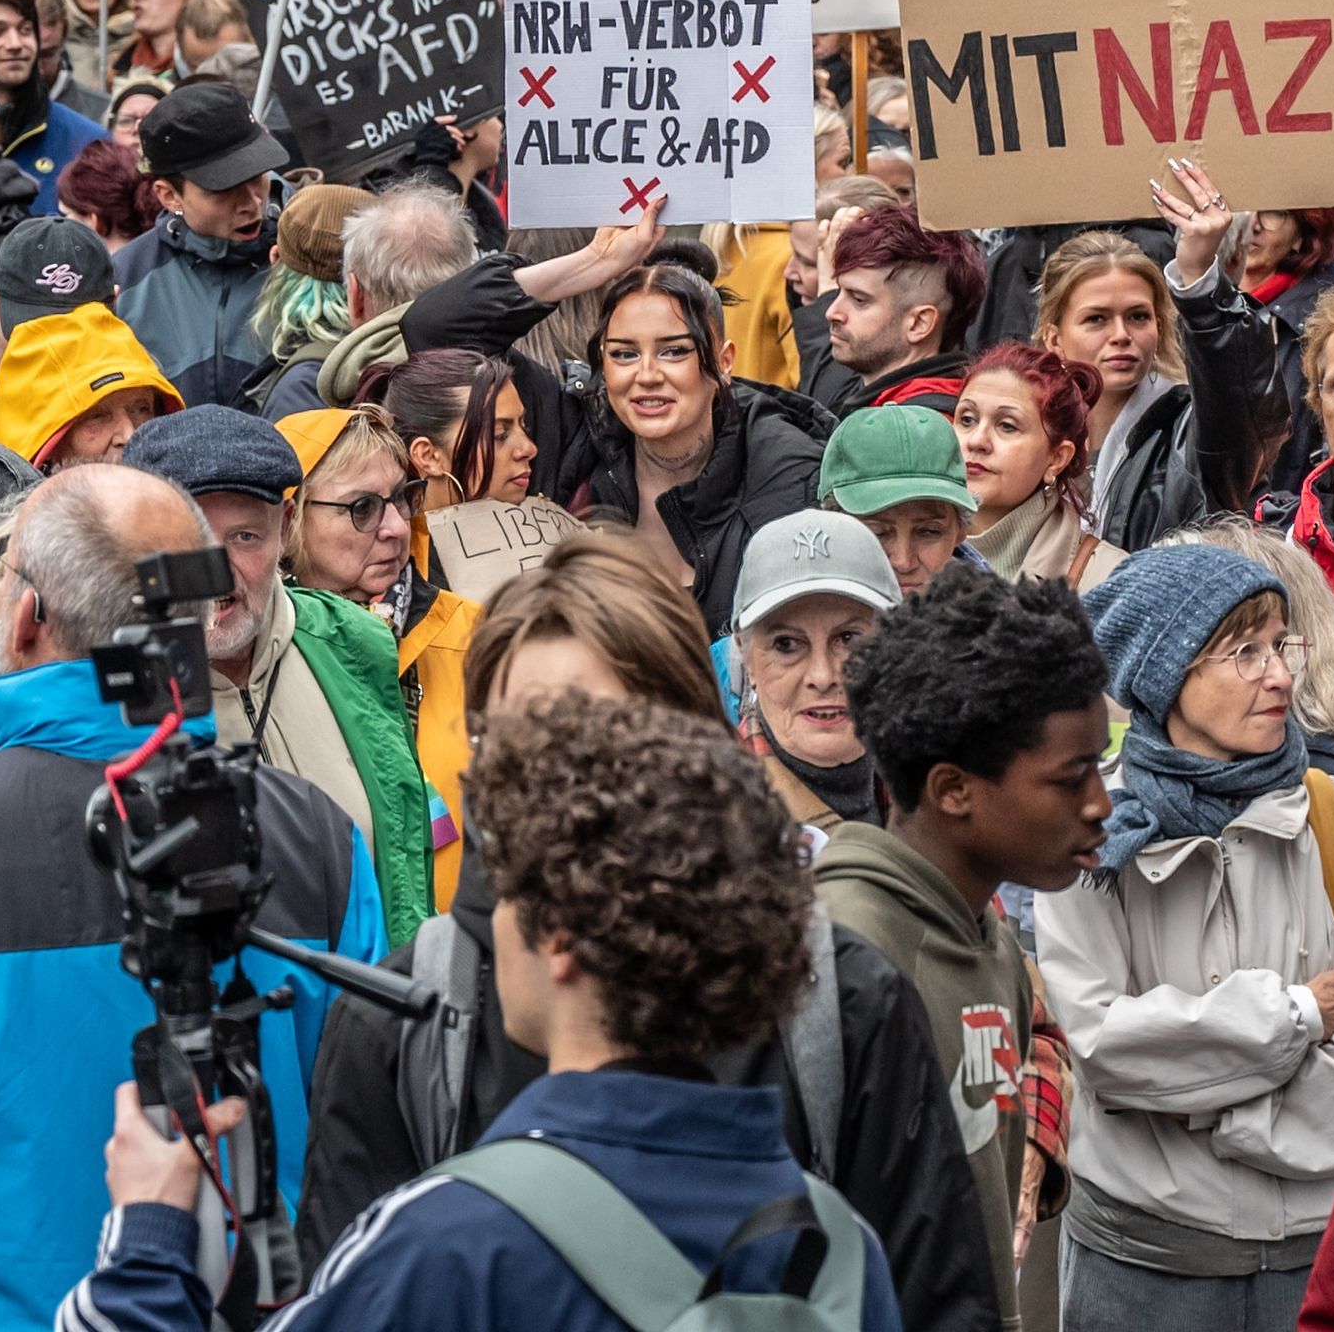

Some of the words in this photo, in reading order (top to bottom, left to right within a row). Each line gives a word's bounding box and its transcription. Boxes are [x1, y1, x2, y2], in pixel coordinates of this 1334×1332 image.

[315, 70, 355, 106] ES
[600, 56, 680, 111] FÜR
[906, 30, 1078, 160] MIT
[514, 118, 647, 166] ALICE
[656, 116, 691, 168] &
[695, 117, 771, 179] AfD
